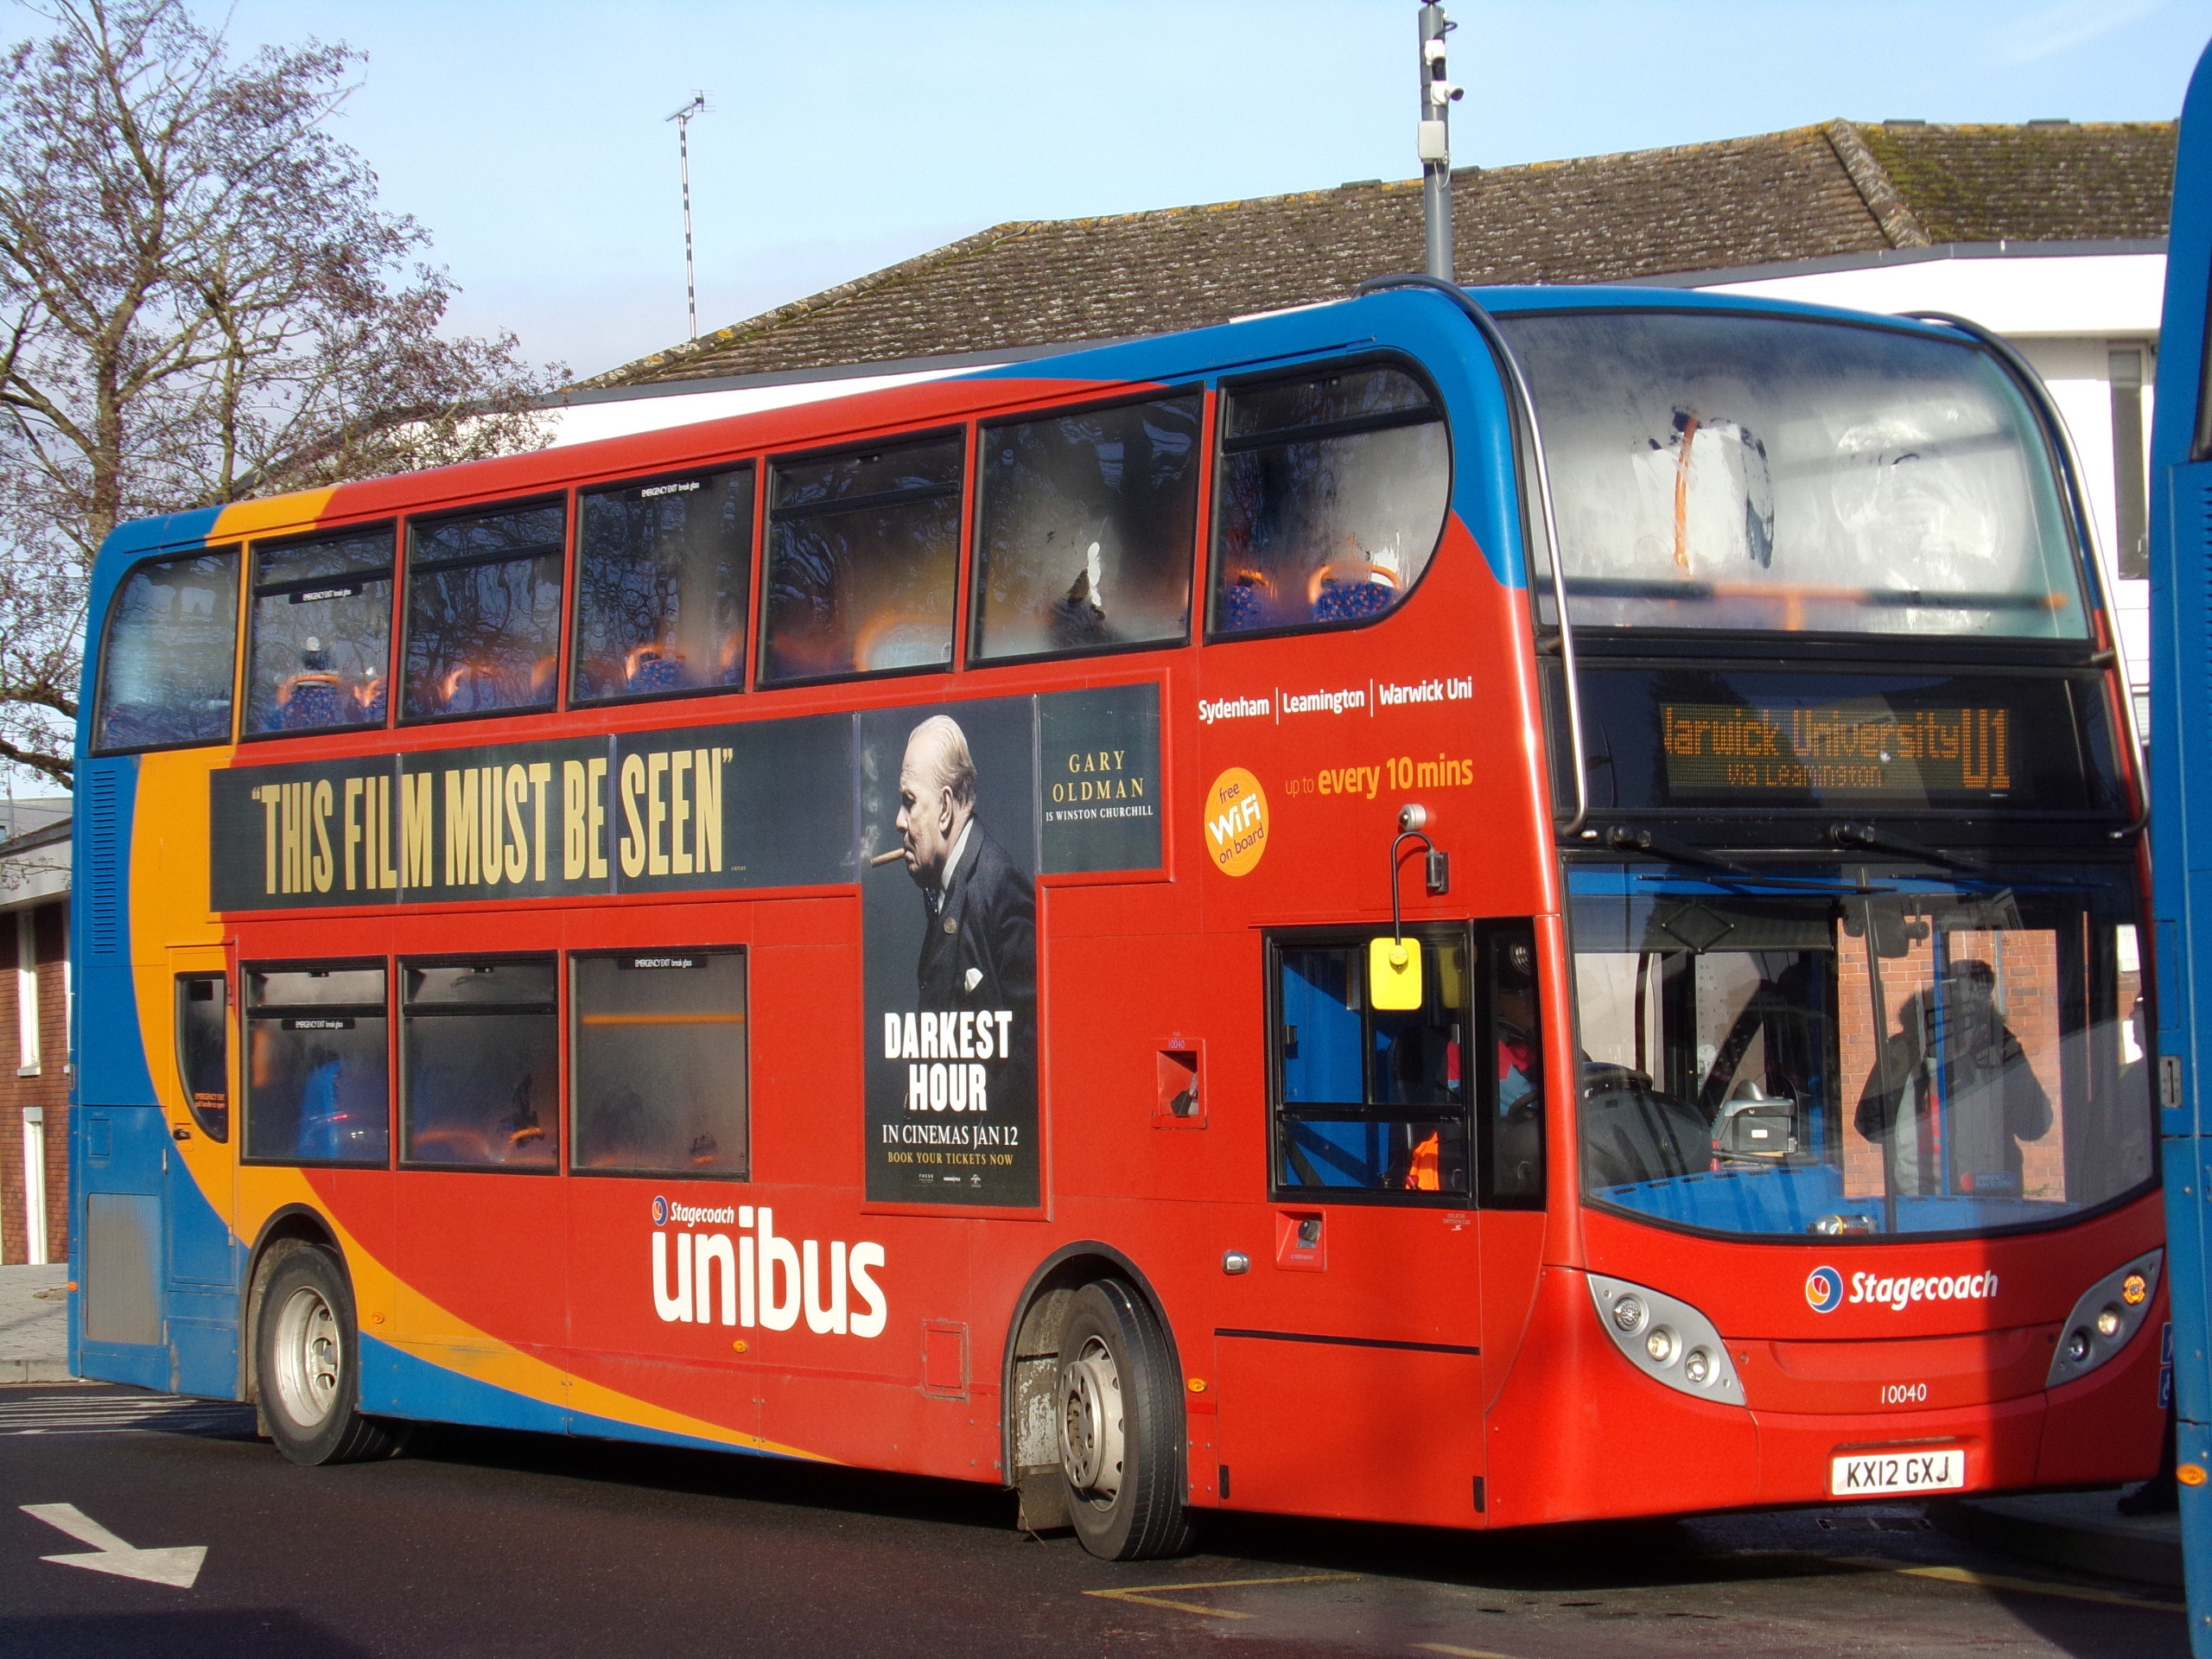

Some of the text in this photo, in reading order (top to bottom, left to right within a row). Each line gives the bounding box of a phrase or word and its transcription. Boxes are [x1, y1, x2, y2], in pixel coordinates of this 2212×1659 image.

[1198, 676, 1472, 725] Sydenham Leamington Warwick Uni
[1794, 709, 1959, 759] University
[1962, 709, 2011, 788] U1
[1068, 750, 1125, 773] GARY
[1286, 753, 1474, 799] up to every 10 mins
[1052, 778, 1144, 803] OLDMAN
[1219, 783, 1240, 804] free
[346, 772, 432, 891] FILM
[445, 762, 550, 886] MUST
[563, 757, 607, 880] BE
[1046, 804, 1153, 822] IS WINSTON CHURCHILL
[1208, 792, 1262, 846] WiFi
[1218, 823, 1264, 865] on board
[884, 1010, 1013, 1059] DARKEST
[1168, 1039, 1185, 1049] 10040
[909, 1063, 987, 1111] HOUR
[882, 1124, 1018, 1150] IN CINEMAS JAN 12
[887, 1151, 1013, 1166] BOOK YOUR TICKETS NOW
[671, 1202, 734, 1228] Stagecoach
[652, 1205, 887, 1338] unibus
[1849, 1269, 1999, 1312] Stagecoach
[1880, 1383, 1927, 1404] 10040
[1847, 1456, 1949, 1488] KX12 GXJ
